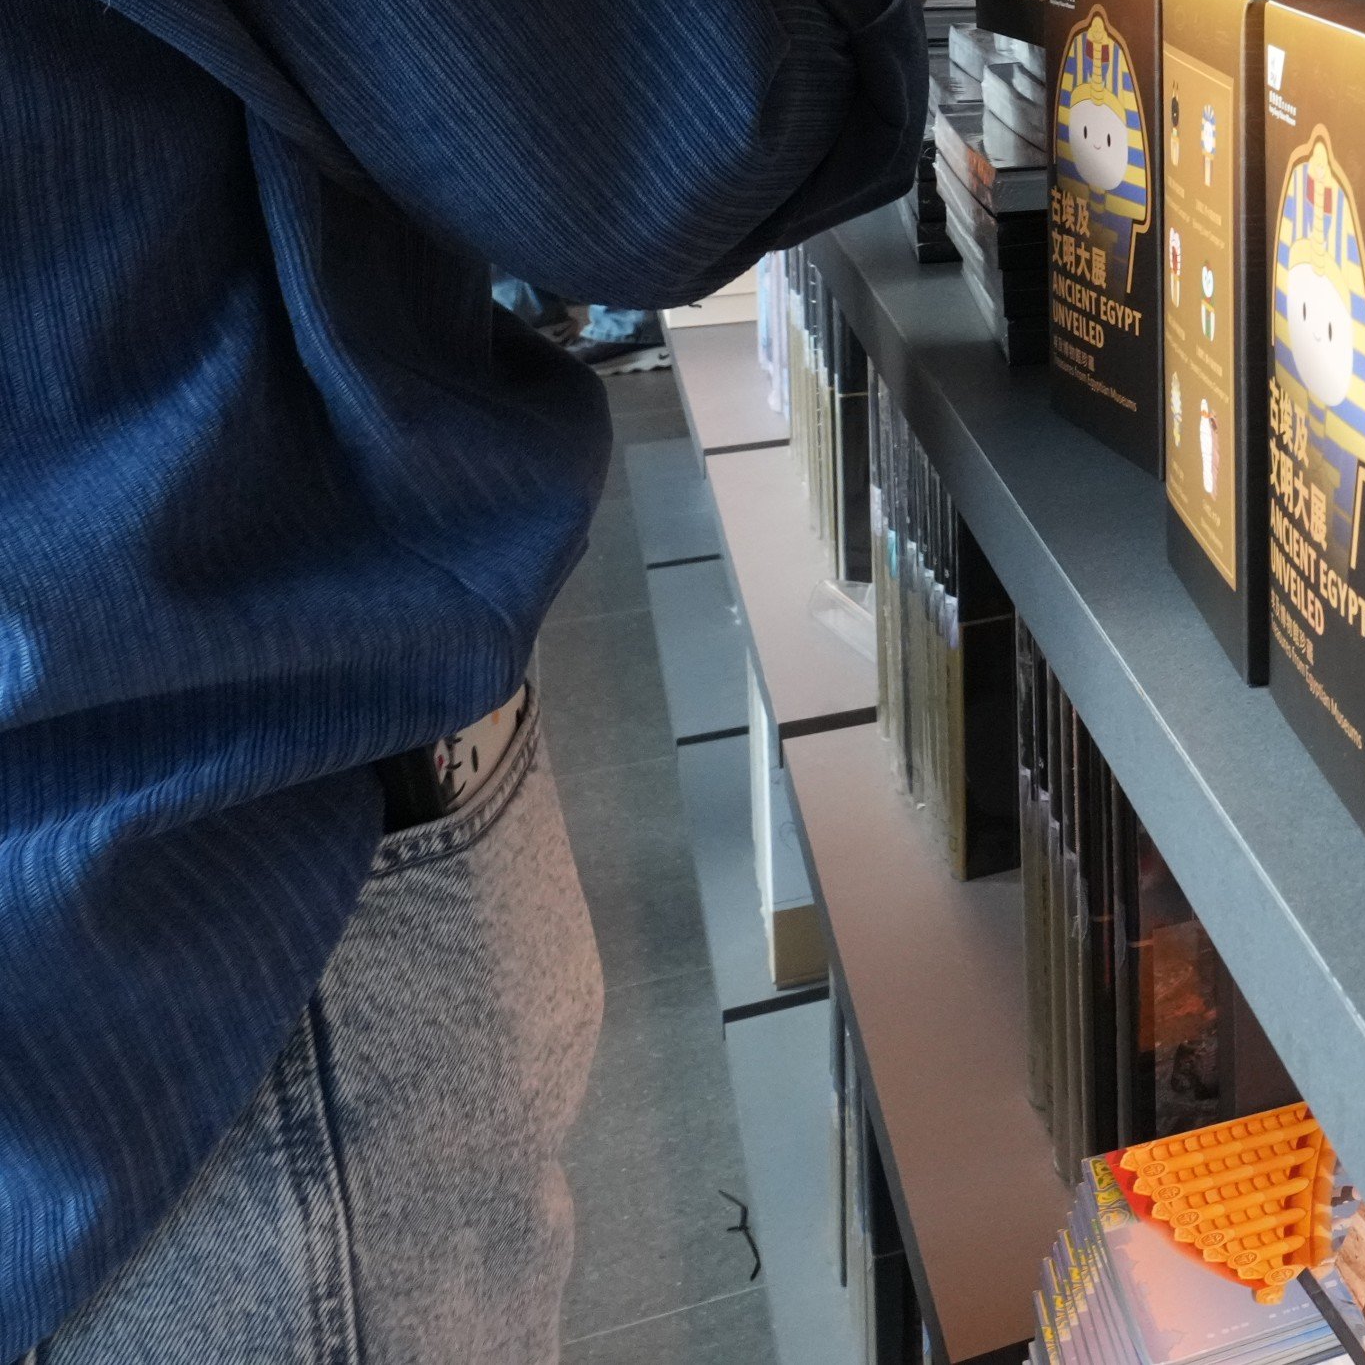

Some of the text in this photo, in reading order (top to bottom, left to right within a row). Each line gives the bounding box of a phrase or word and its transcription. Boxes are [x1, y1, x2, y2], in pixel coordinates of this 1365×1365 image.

[1051, 186, 1090, 238] 古埃及
[1052, 228, 1107, 289] 文明大展
[1053, 270, 1142, 337] ANCIENT EGYPT
[1053, 299, 1105, 349] UNVEILED
[1269, 376, 1309, 469] 古埃及
[1269, 437, 1328, 552] 文明大展
[1270, 498, 1318, 582] ANCIENT
[1270, 545, 1325, 636] UNVEILED
